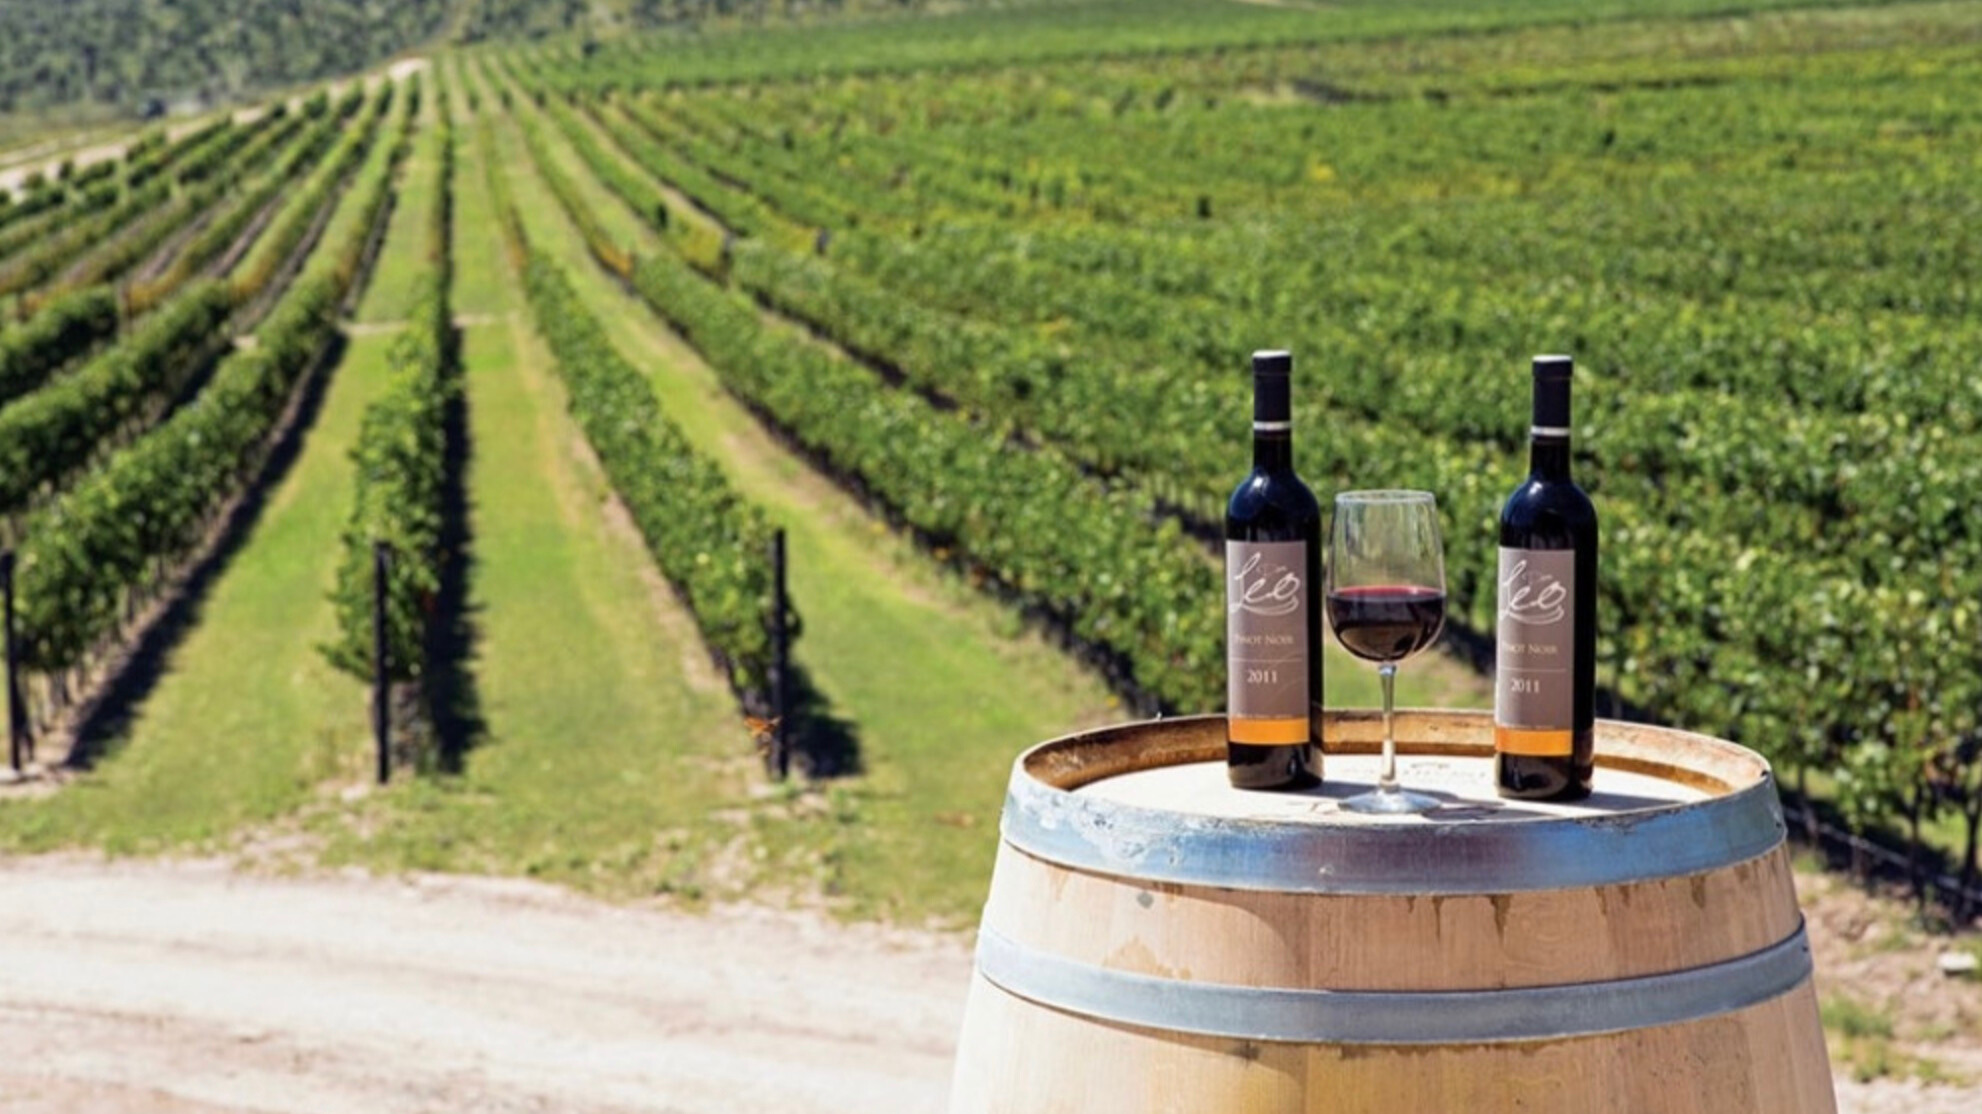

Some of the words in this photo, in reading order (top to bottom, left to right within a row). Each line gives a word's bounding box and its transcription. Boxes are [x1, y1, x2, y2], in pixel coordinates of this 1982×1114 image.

[1229, 551, 1301, 616] Leo
[1500, 560, 1567, 625] Leo
[1247, 668, 1278, 684] 2011
[1511, 678, 1541, 694] 2011
